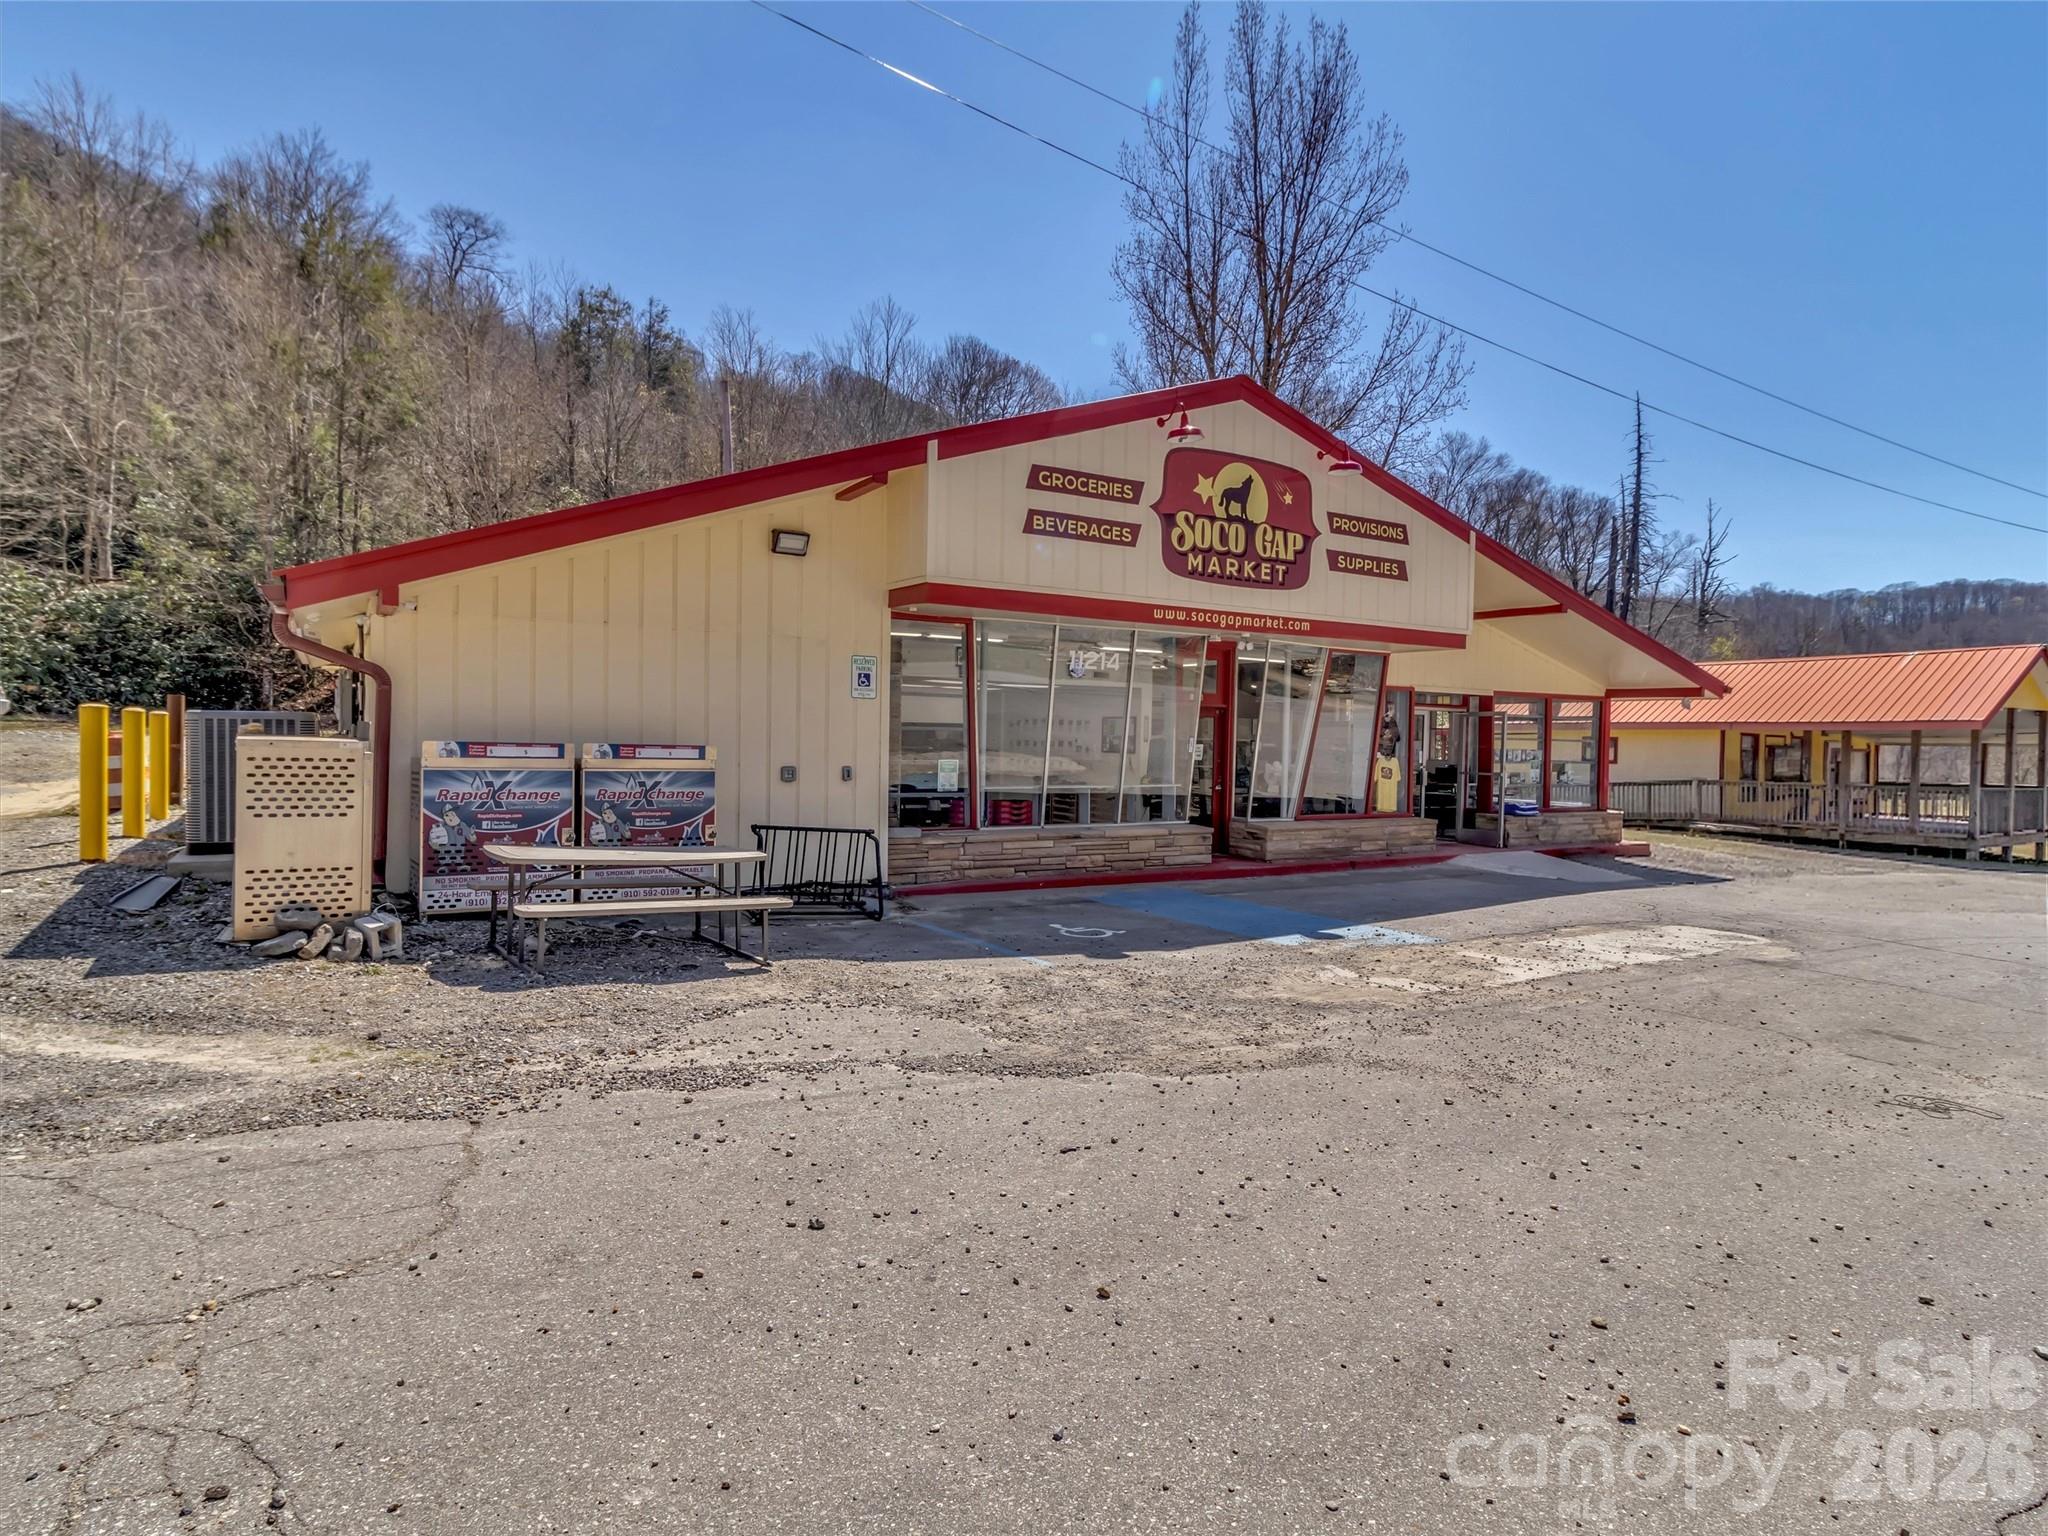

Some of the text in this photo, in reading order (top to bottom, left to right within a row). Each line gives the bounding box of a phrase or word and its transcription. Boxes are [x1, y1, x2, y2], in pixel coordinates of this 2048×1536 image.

[1038, 471, 1134, 499] GROCERIES
[1032, 515, 1132, 542] BEVERAGES
[1332, 517, 1404, 540] PROVISIONS
[1255, 523, 1304, 560] GAP
[1187, 553, 1287, 583] MARKET
[1337, 555, 1399, 576] SUPPLIES
[1153, 608, 1310, 631] www.socogapmarket.com
[1069, 650, 1120, 671] 11214
[639, 867, 666, 875] PROPANE
[438, 890, 473, 898] 24-Hour
[465, 898, 488, 906] (910)
[643, 888, 680, 896] 592-0199
